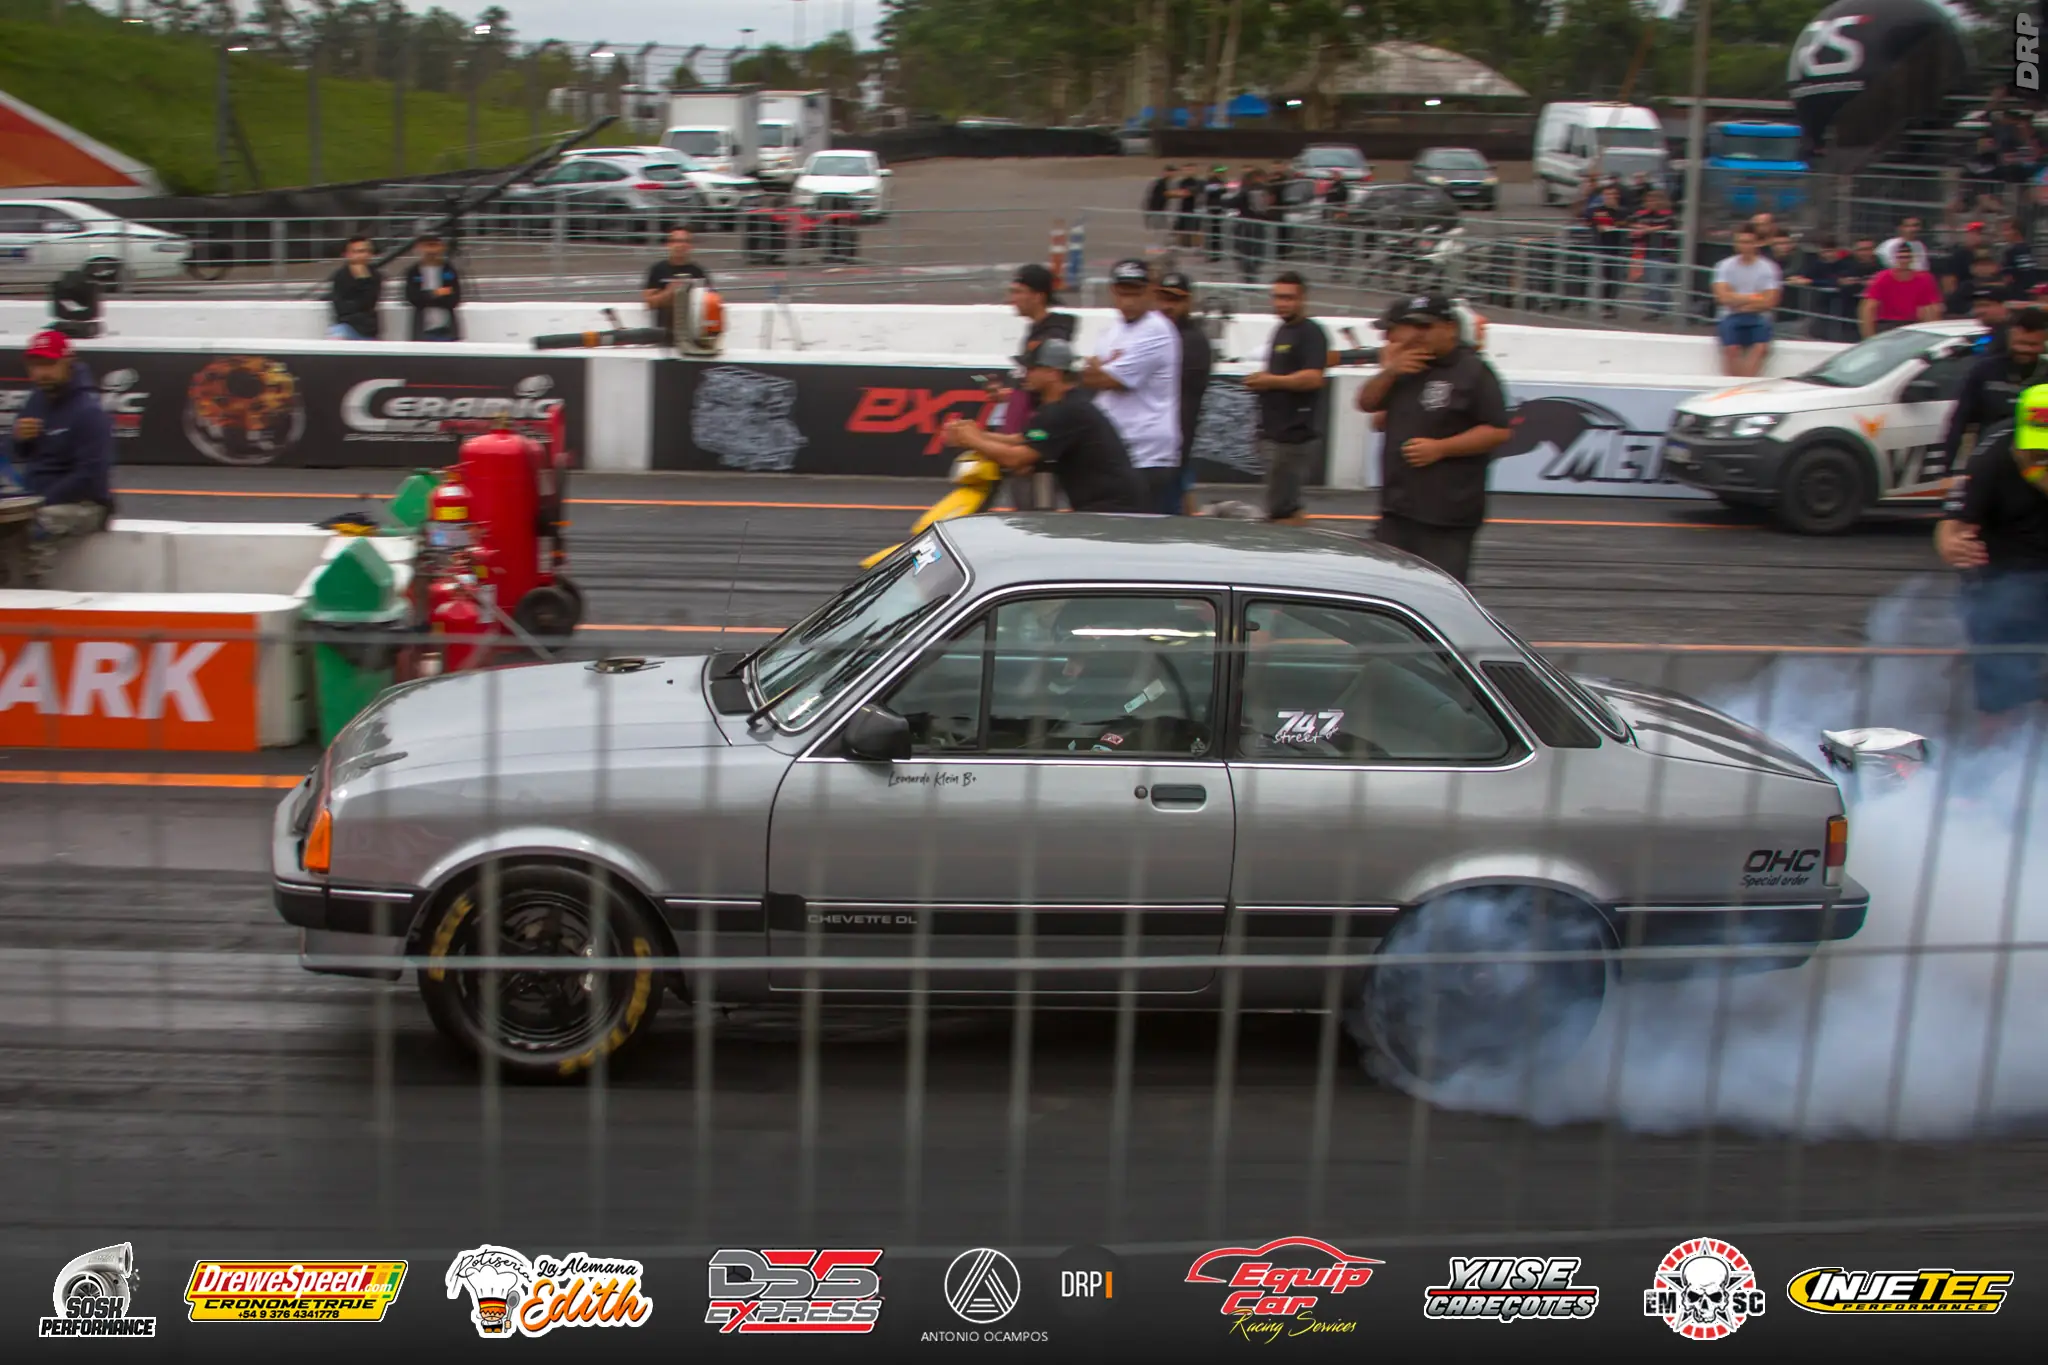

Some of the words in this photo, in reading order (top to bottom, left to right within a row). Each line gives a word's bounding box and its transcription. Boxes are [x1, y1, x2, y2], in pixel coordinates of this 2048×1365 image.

[0, 641, 226, 722] ARK
[1277, 709, 1344, 736] 747
[1743, 849, 1820, 872] OHC
[1740, 875, 1780, 887] Special
[1781, 875, 1809, 886] order
[808, 915, 892, 924] CHEVETTE
[896, 915, 918, 924] DL
